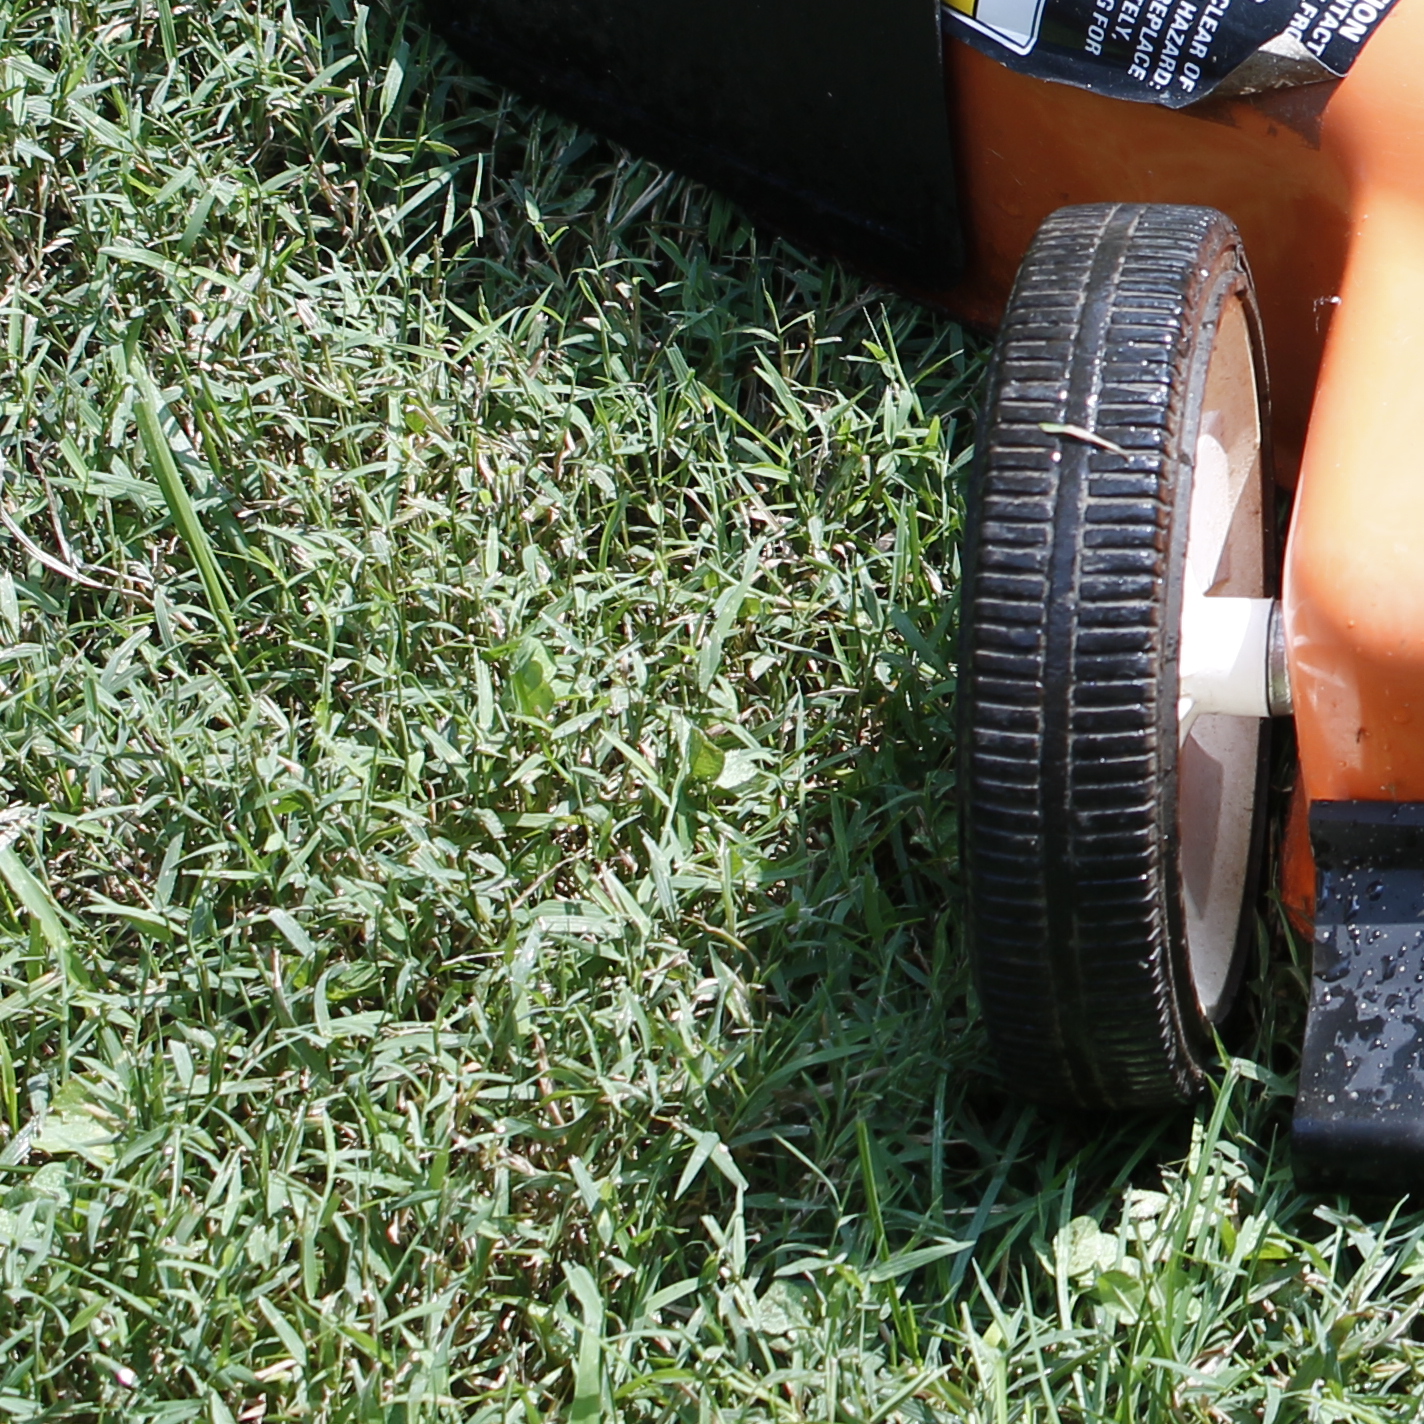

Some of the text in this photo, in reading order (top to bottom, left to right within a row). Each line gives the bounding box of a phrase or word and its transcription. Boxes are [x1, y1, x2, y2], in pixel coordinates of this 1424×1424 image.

[1084, 11, 1108, 56] FOR
[1283, 2, 1318, 42] FRO
[1149, 0, 1197, 90] HAZARD:
[1179, 61, 1201, 94] OF
